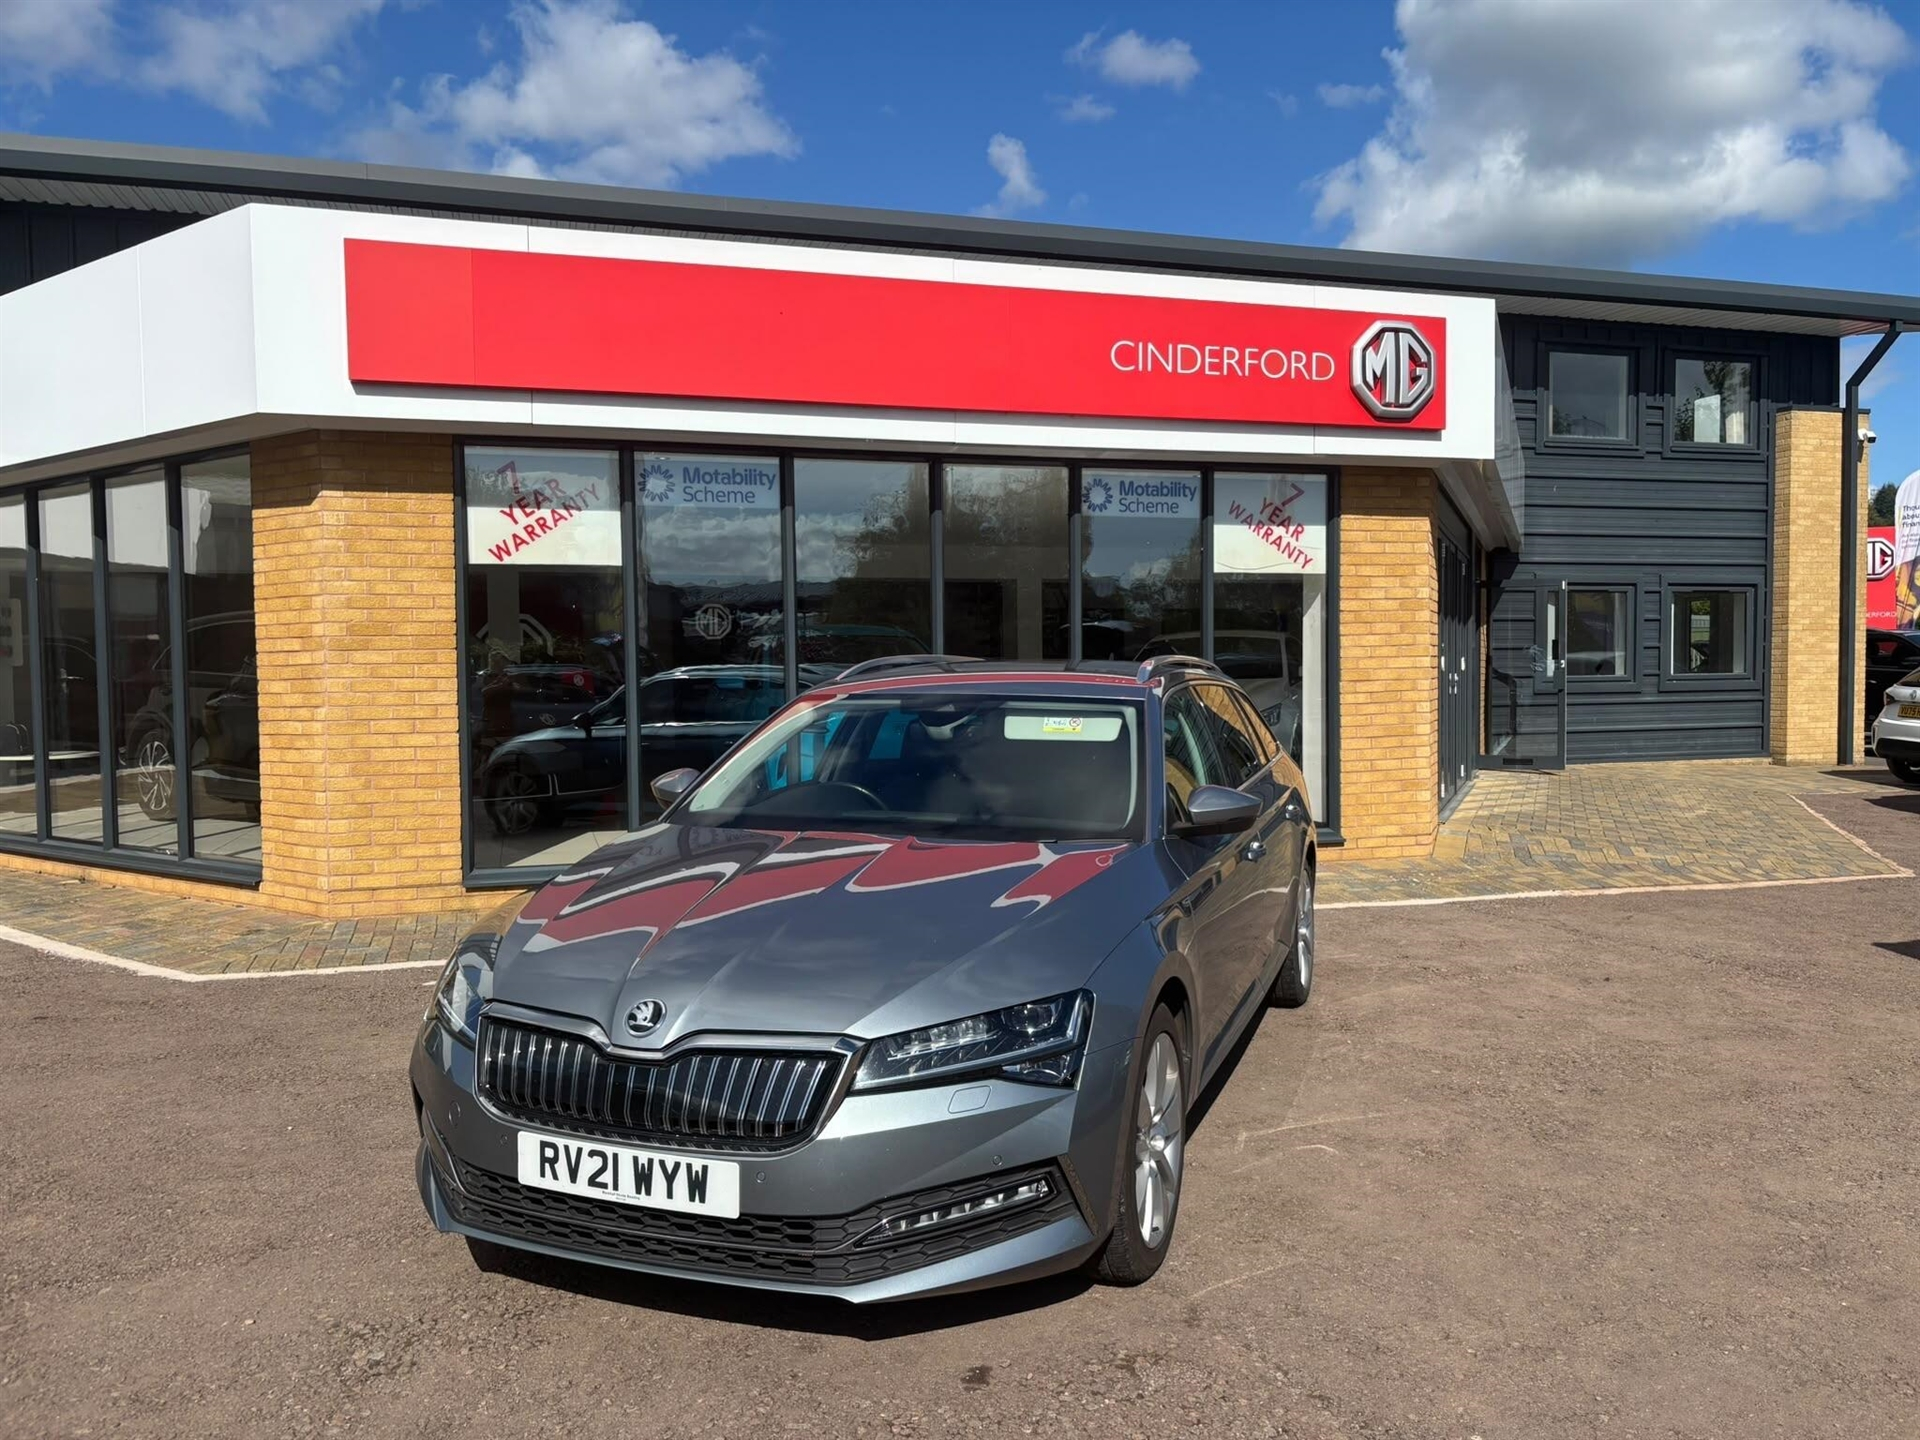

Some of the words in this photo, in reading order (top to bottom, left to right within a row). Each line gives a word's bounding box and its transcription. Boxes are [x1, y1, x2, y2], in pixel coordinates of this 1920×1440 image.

[1110, 340, 1336, 382] CINDERFORD
[1361, 328, 1432, 409] MG
[496, 460, 521, 495] 7
[682, 466, 777, 491] Motability
[682, 485, 756, 504] Scheme
[1118, 480, 1198, 502] Motability
[1280, 482, 1306, 508] 7
[487, 482, 601, 563] WARRANTY
[499, 478, 567, 527] YEAR
[1118, 497, 1180, 514] Scheme
[1259, 496, 1306, 543] YEAR
[1227, 499, 1314, 570] WARRANTY
[539, 1139, 620, 1192] RV21
[632, 1155, 710, 1205] WYW
